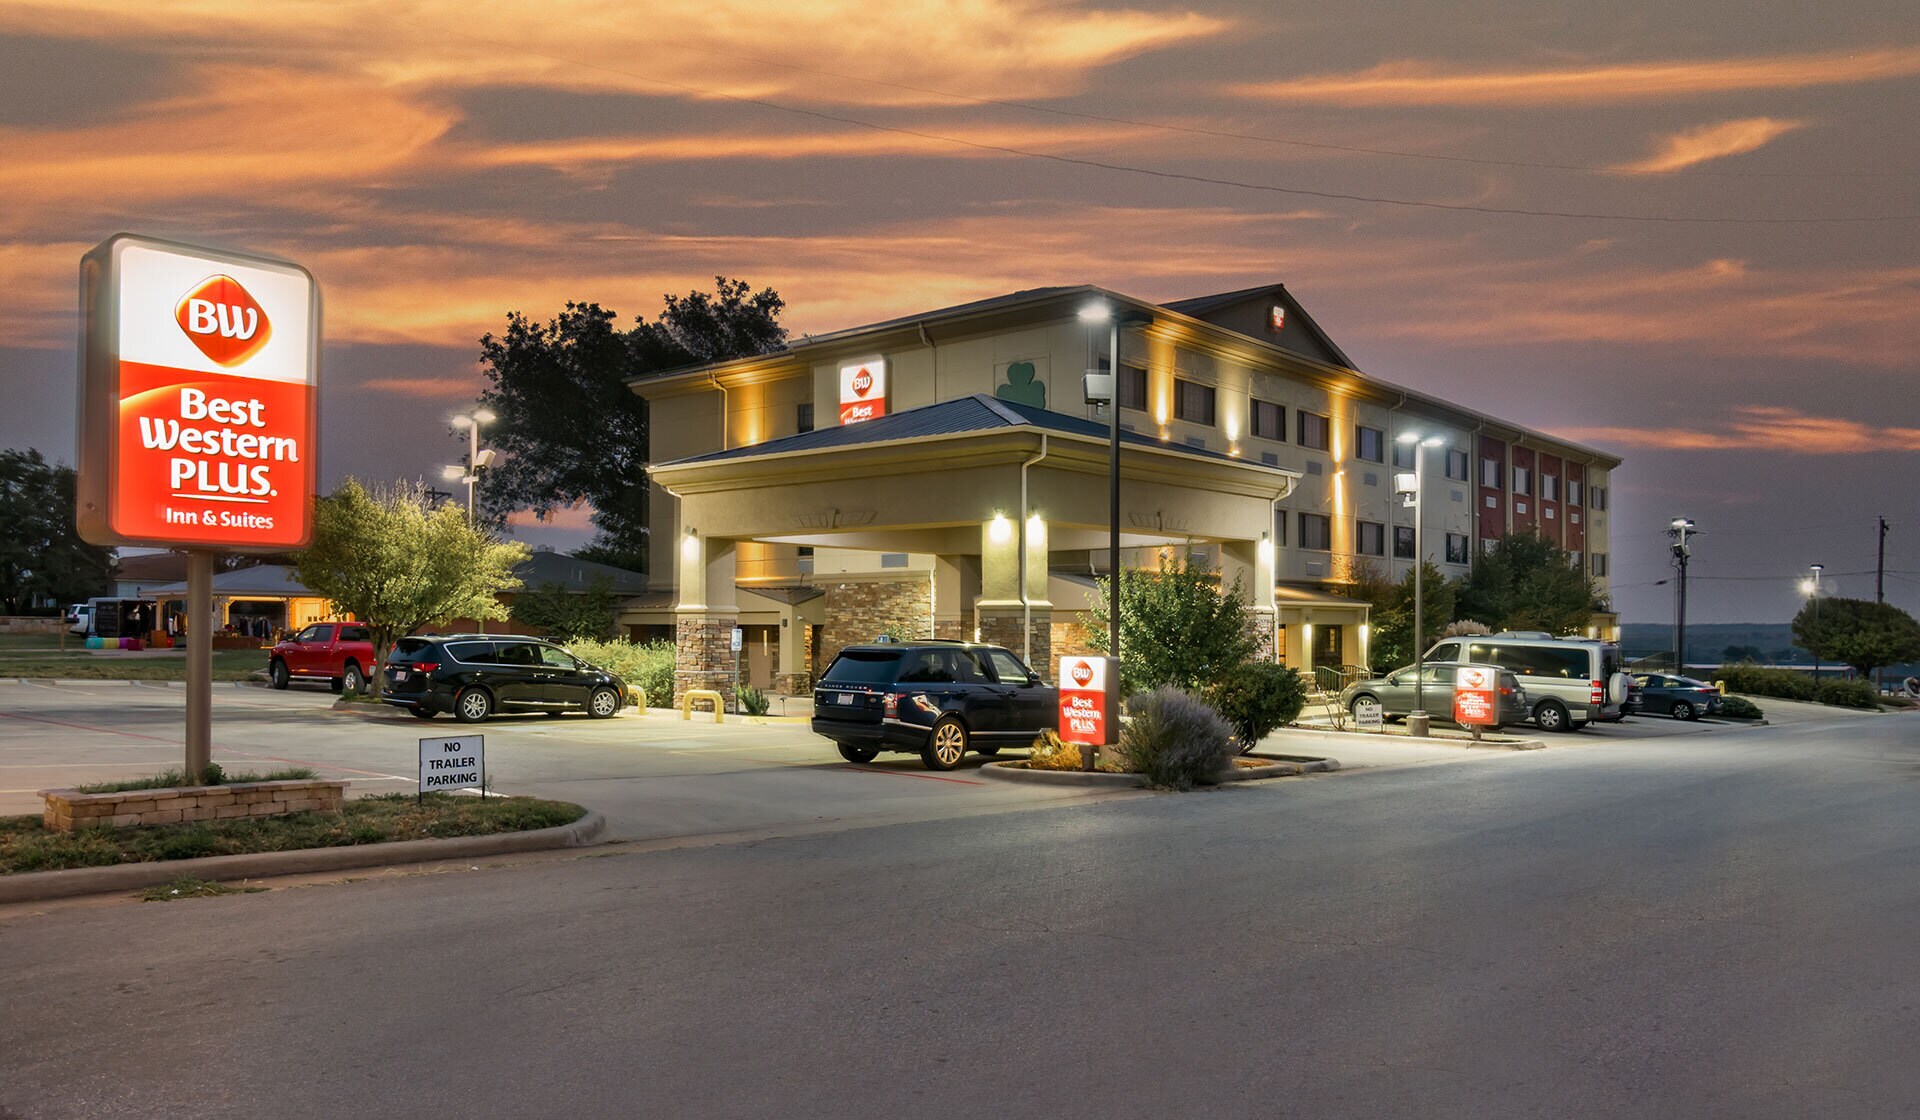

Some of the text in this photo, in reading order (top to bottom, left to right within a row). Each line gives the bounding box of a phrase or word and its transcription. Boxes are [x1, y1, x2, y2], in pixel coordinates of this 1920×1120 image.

[188, 298, 258, 340] BW
[854, 376, 870, 390] BW
[180, 387, 266, 428] Best
[852, 404, 873, 418] Best
[138, 416, 299, 463] Western
[166, 507, 275, 530] Inn & Suites
[1073, 667, 1091, 680] BW
[1071, 696, 1093, 708] Best
[1063, 706, 1102, 721] Western
[444, 741, 461, 753] NO
[429, 757, 476, 770] TRAILER
[427, 772, 477, 786] PARKING
